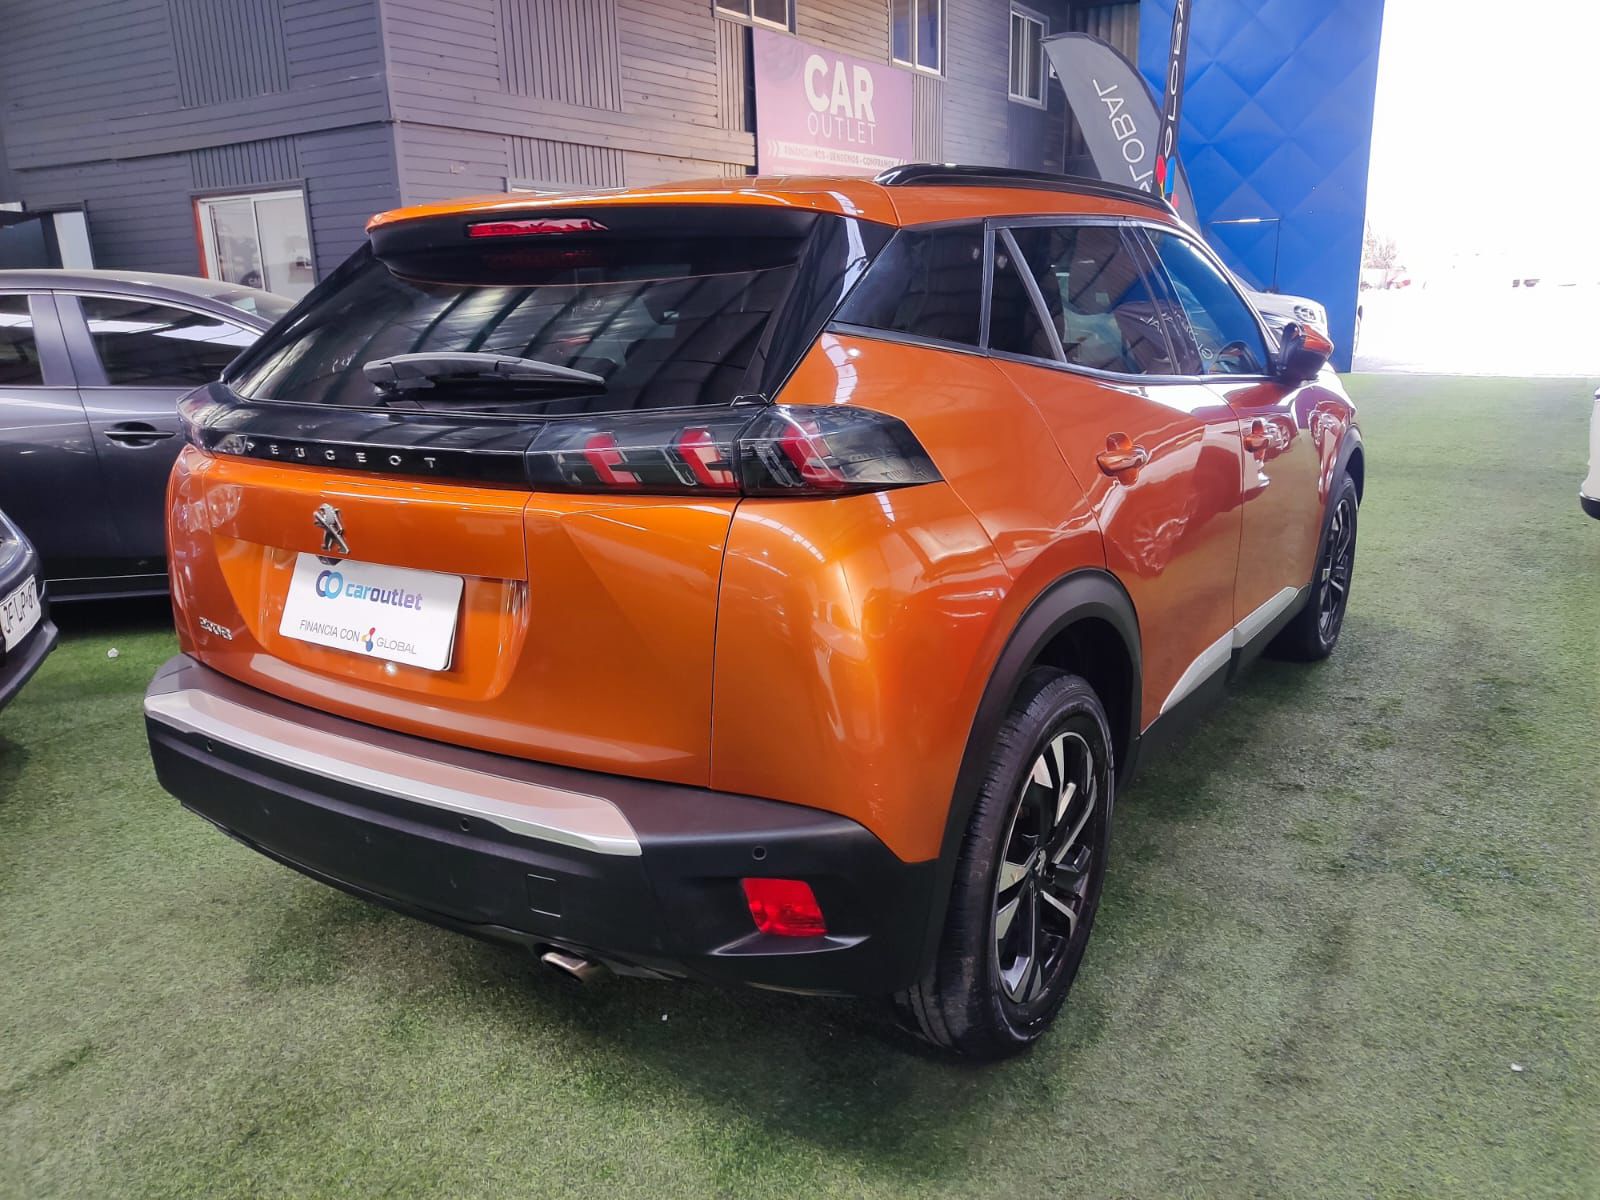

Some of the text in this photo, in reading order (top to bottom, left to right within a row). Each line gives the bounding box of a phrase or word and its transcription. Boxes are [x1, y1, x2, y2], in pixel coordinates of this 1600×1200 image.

[804, 54, 876, 123] CAR
[807, 112, 876, 145] OUTLET
[247, 441, 436, 469] PEUGEOT
[345, 582, 423, 611] caroutlet
[299, 619, 417, 655] FINANCIA CON GLOBAL
